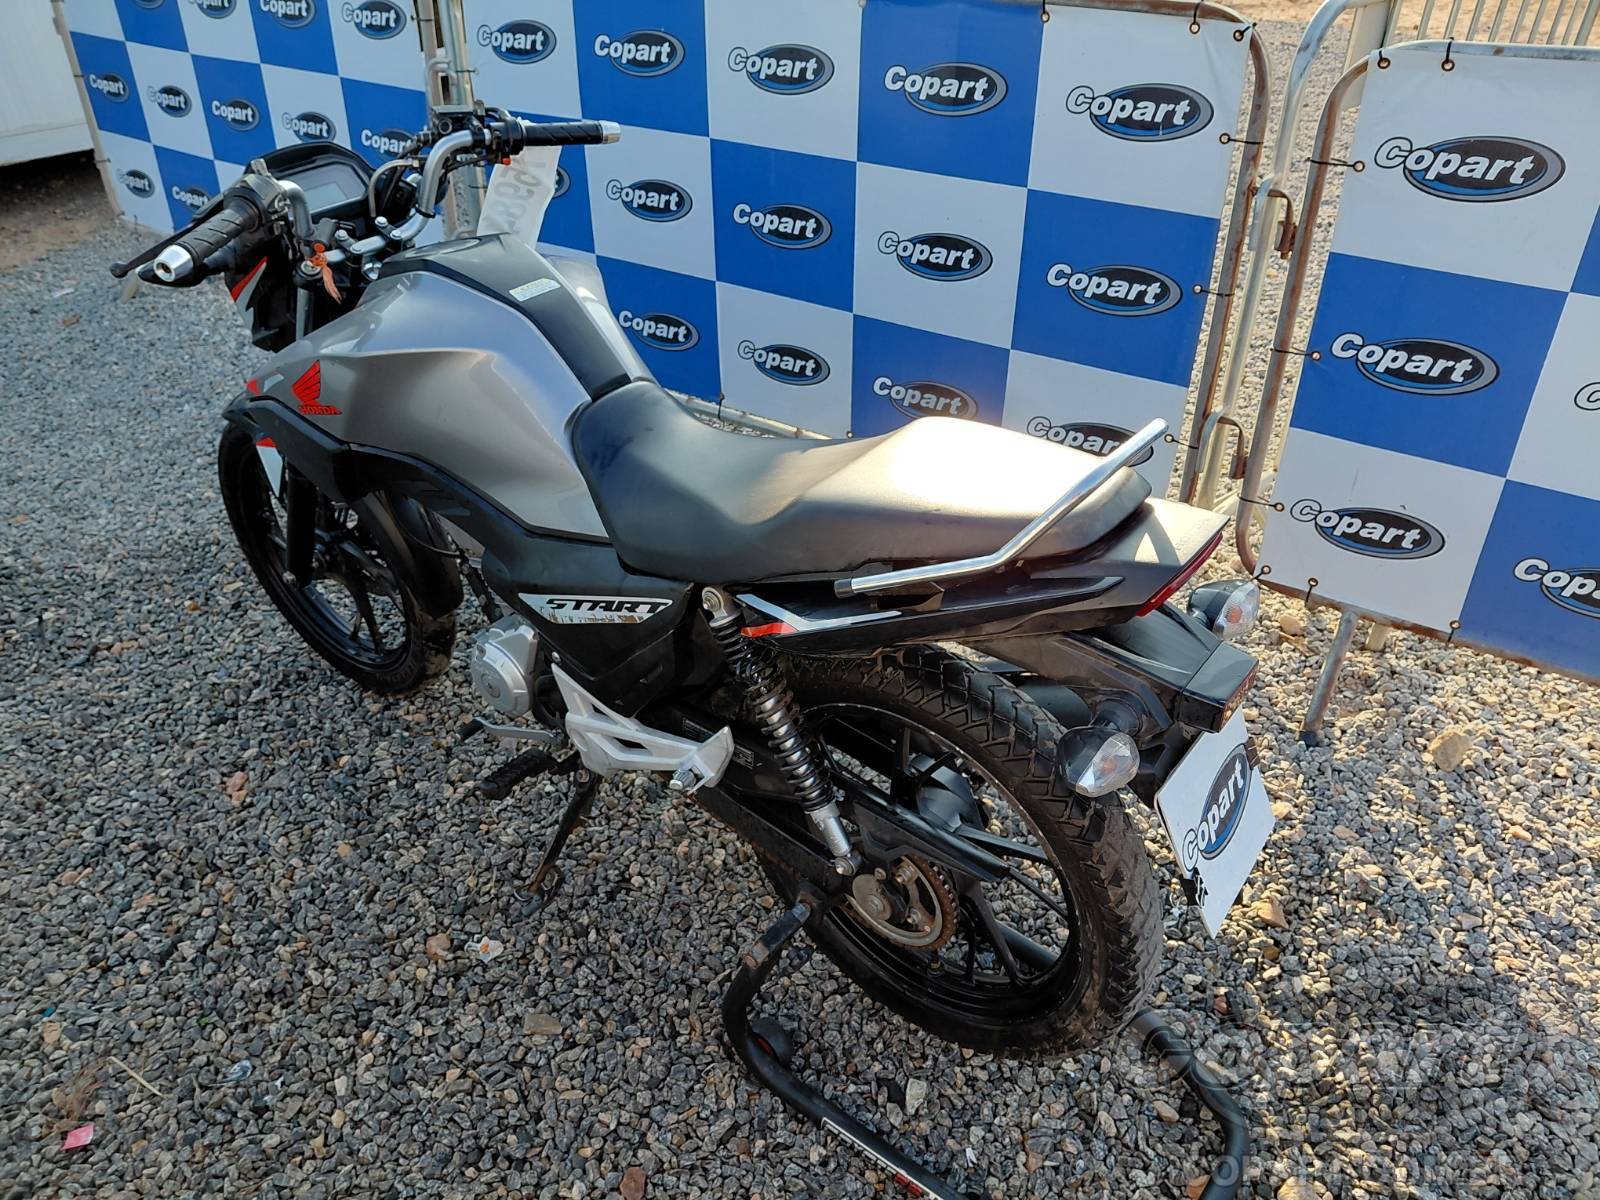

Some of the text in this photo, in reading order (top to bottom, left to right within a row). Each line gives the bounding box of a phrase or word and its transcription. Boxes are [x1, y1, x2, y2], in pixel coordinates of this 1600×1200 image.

[188, 0, 230, 9] part
[260, 0, 308, 17] Copart
[342, 4, 397, 28] Copart
[477, 24, 545, 52] Copart
[594, 34, 671, 65] Copart
[728, 47, 819, 82] Copart
[89, 73, 125, 97] Copart
[147, 85, 186, 109] Copart
[884, 64, 990, 102] Copart
[211, 100, 254, 122] Copart
[1065, 85, 1192, 127] Copart
[282, 112, 329, 138] Copart
[1374, 136, 1538, 185] Copart
[116, 168, 150, 191] Copart
[606, 179, 680, 212] Copart
[733, 203, 819, 239] Copart
[877, 231, 975, 271] Copart
[1046, 263, 1162, 305] Copart
[618, 310, 688, 344] Copart
[737, 340, 817, 378] Copart
[1330, 333, 1474, 384] Copart
[873, 376, 964, 417] Copart
[1027, 416, 1121, 455] Copar
[1290, 498, 1423, 551] Copart
[1513, 558, 1600, 600] Cop
[545, 598, 670, 614] START
[1183, 757, 1244, 873] Copart
